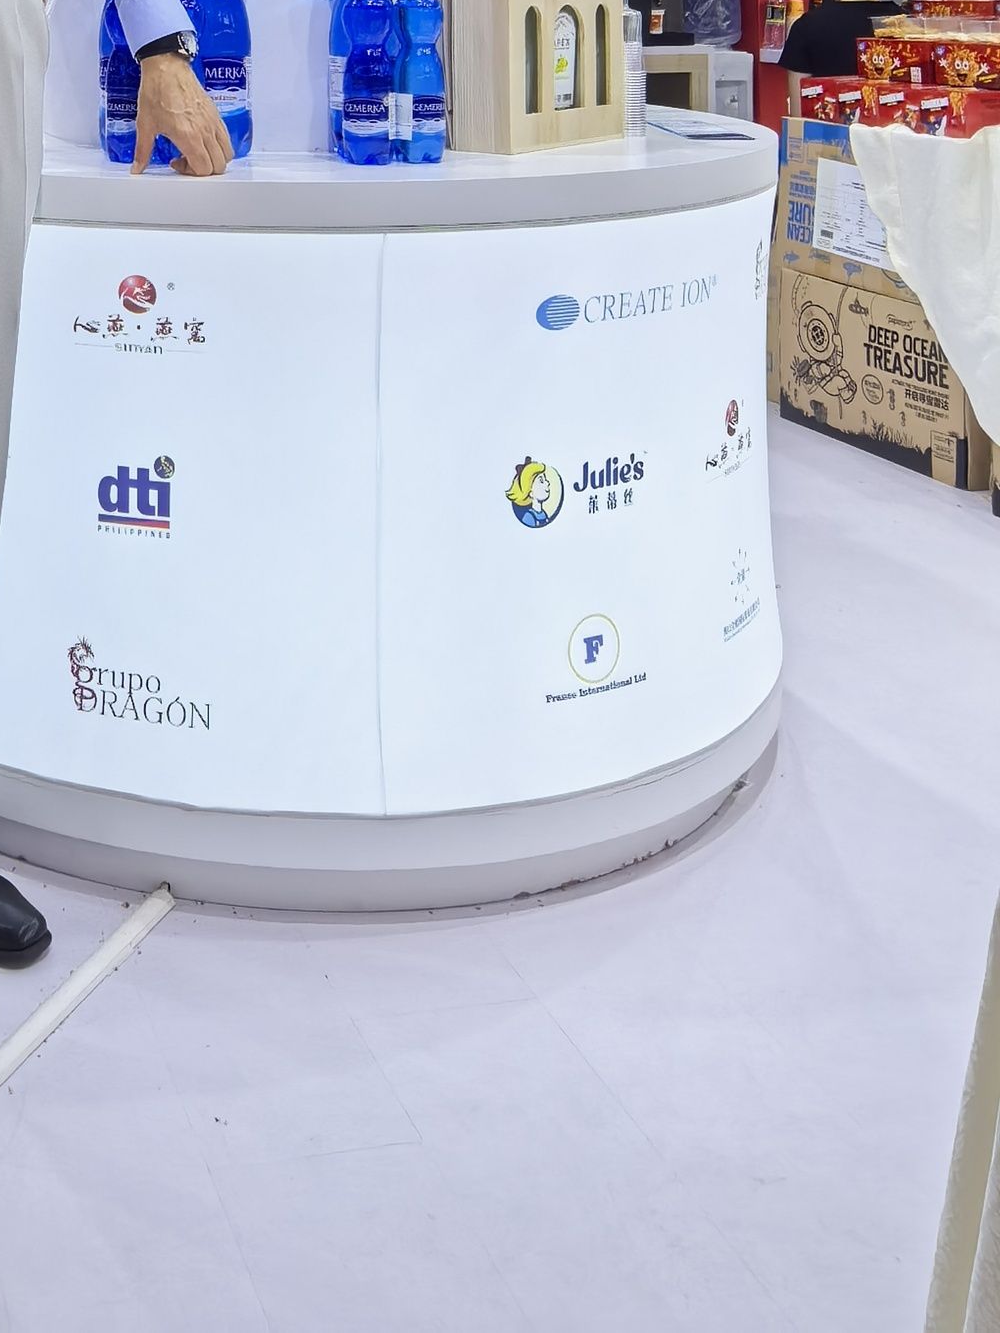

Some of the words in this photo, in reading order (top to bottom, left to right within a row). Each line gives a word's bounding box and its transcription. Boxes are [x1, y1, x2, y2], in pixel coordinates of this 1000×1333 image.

[204, 66, 247, 81] MERKA
[344, 103, 387, 114] GEMERKA
[584, 284, 674, 324] CREATE
[868, 324, 899, 350] DEEP
[863, 342, 950, 390] TREASURE
[98, 455, 175, 518] dti
[572, 452, 645, 493] Julie's
[97, 524, 171, 539] PHILIPPINES
[583, 633, 604, 665] F
[578, 676, 633, 698] International
[634, 671, 647, 684] Ltd
